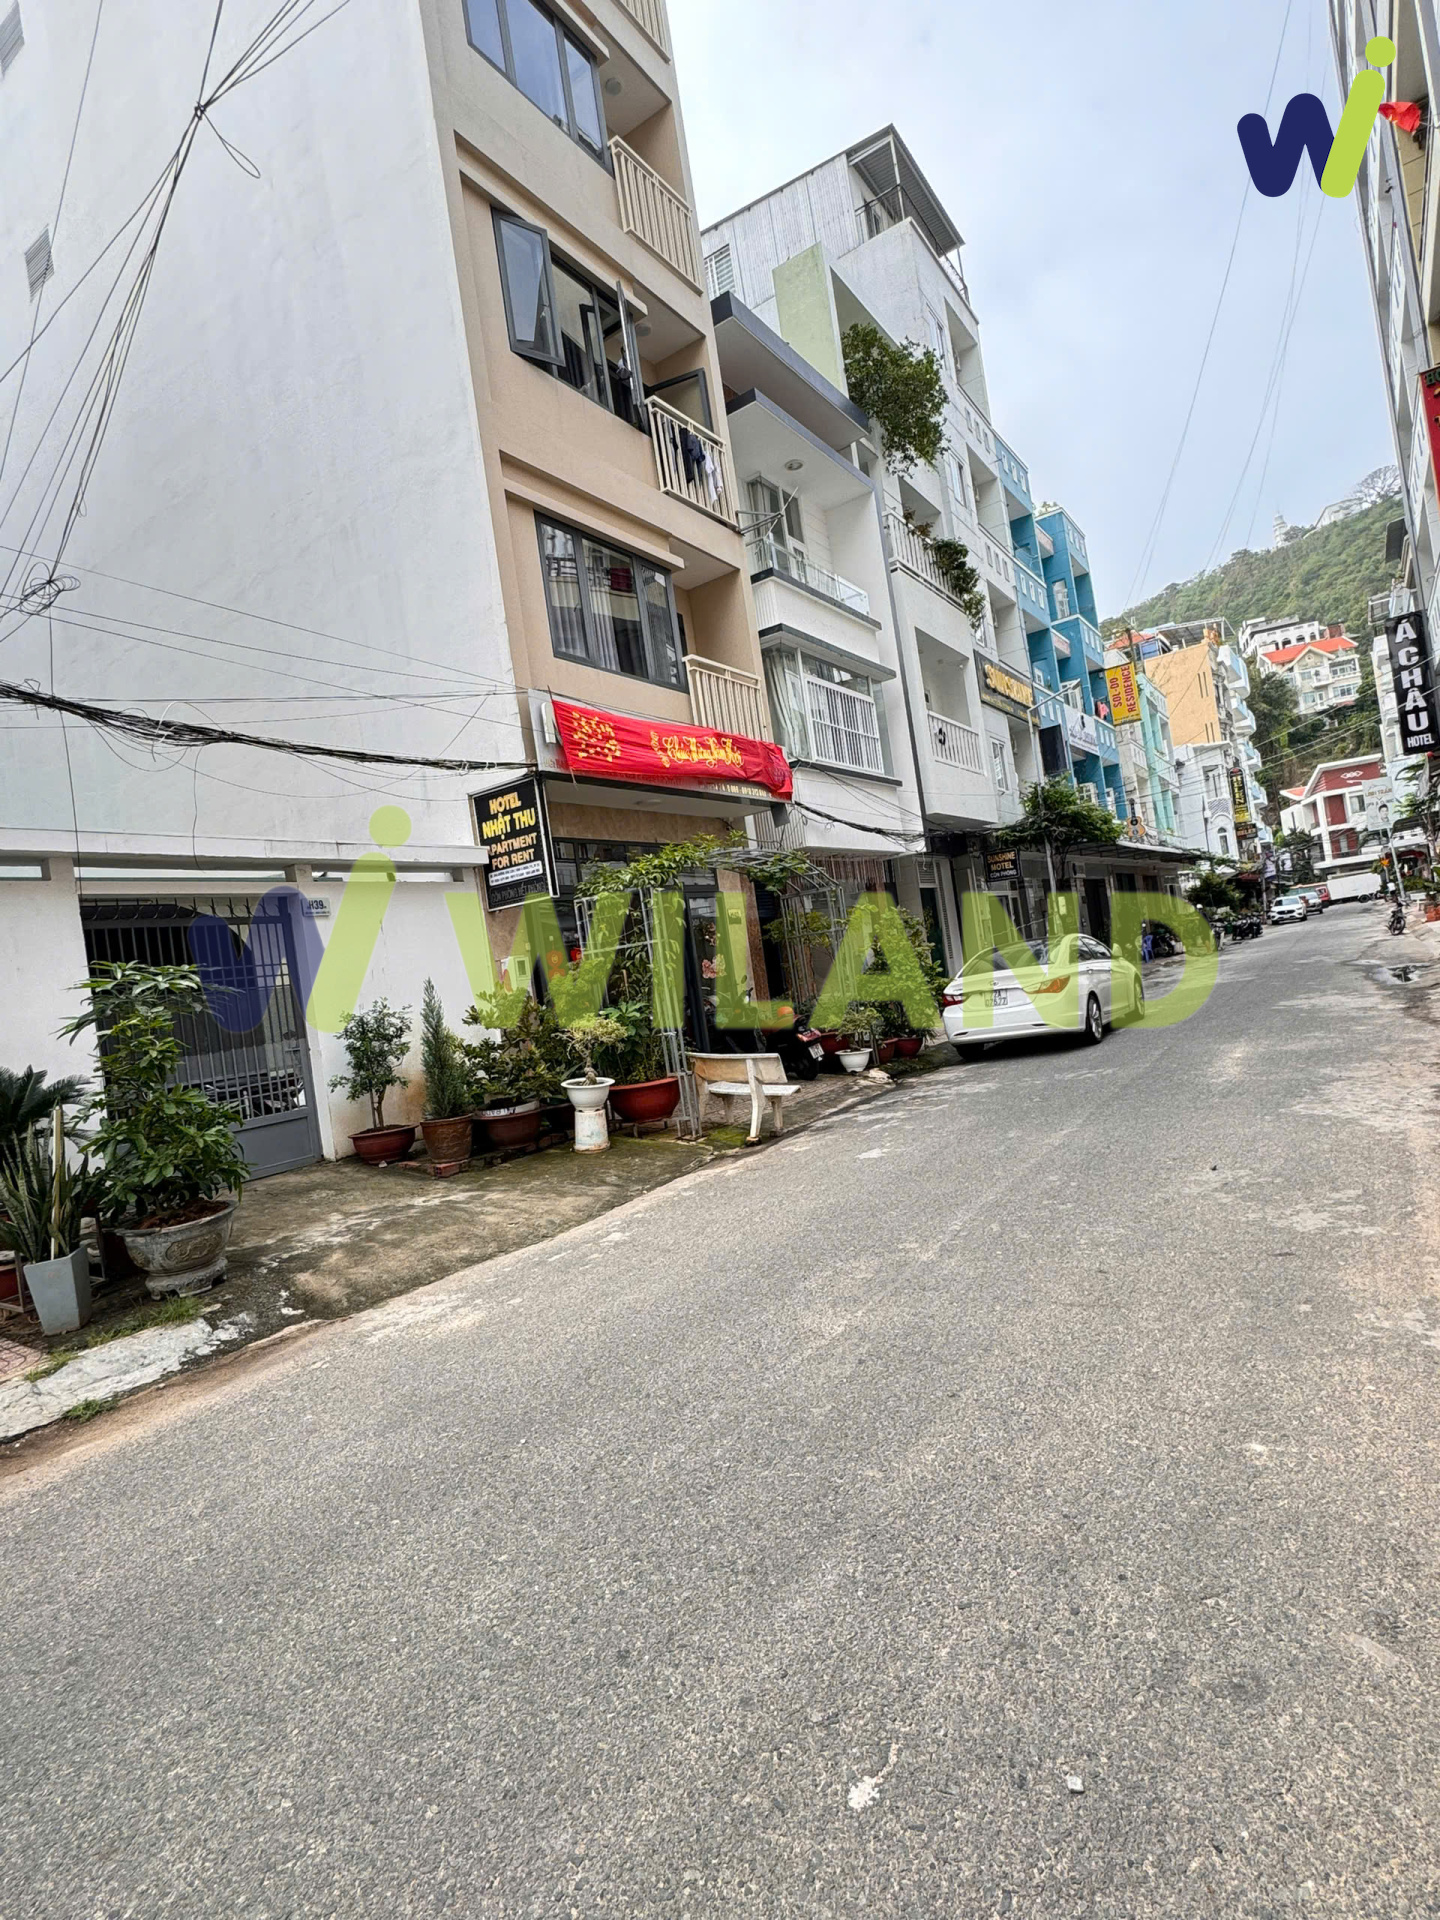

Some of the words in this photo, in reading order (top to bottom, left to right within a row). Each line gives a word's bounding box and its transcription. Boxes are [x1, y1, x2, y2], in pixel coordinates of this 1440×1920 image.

[1121, 666, 1137, 713] RESIDENCE
[1407, 733, 1435, 748] HOTEL
[489, 792, 521, 815] HOTEL
[482, 813, 511, 840] NHẬT
[513, 807, 536, 831] THU
[492, 856, 511, 871] FOR
[511, 848, 535, 866] RENT
[987, 851, 1015, 863] SUNSHINE
[991, 861, 1014, 871] MOTEL
